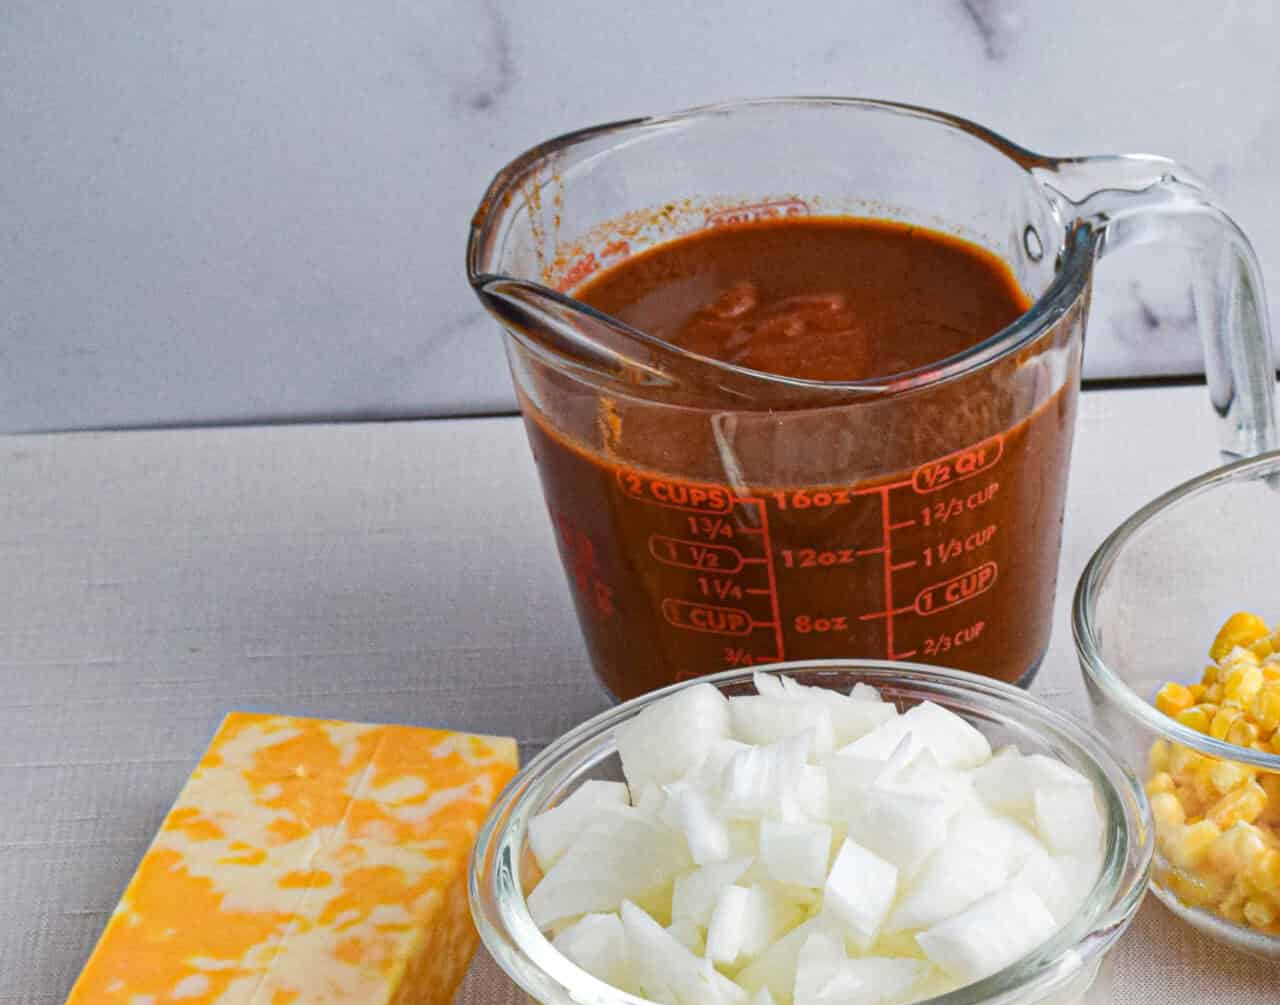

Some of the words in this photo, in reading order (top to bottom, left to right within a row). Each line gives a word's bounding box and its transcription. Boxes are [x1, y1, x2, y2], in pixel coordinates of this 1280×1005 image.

[651, 481, 725, 509] CUPS
[774, 490, 852, 511] 16oz
[967, 482, 999, 511] CUP
[965, 523, 997, 550] CUP
[782, 549, 855, 568] 12oz
[944, 567, 993, 604] CUP
[690, 608, 745, 631] CUP
[954, 620, 986, 647] CUP
